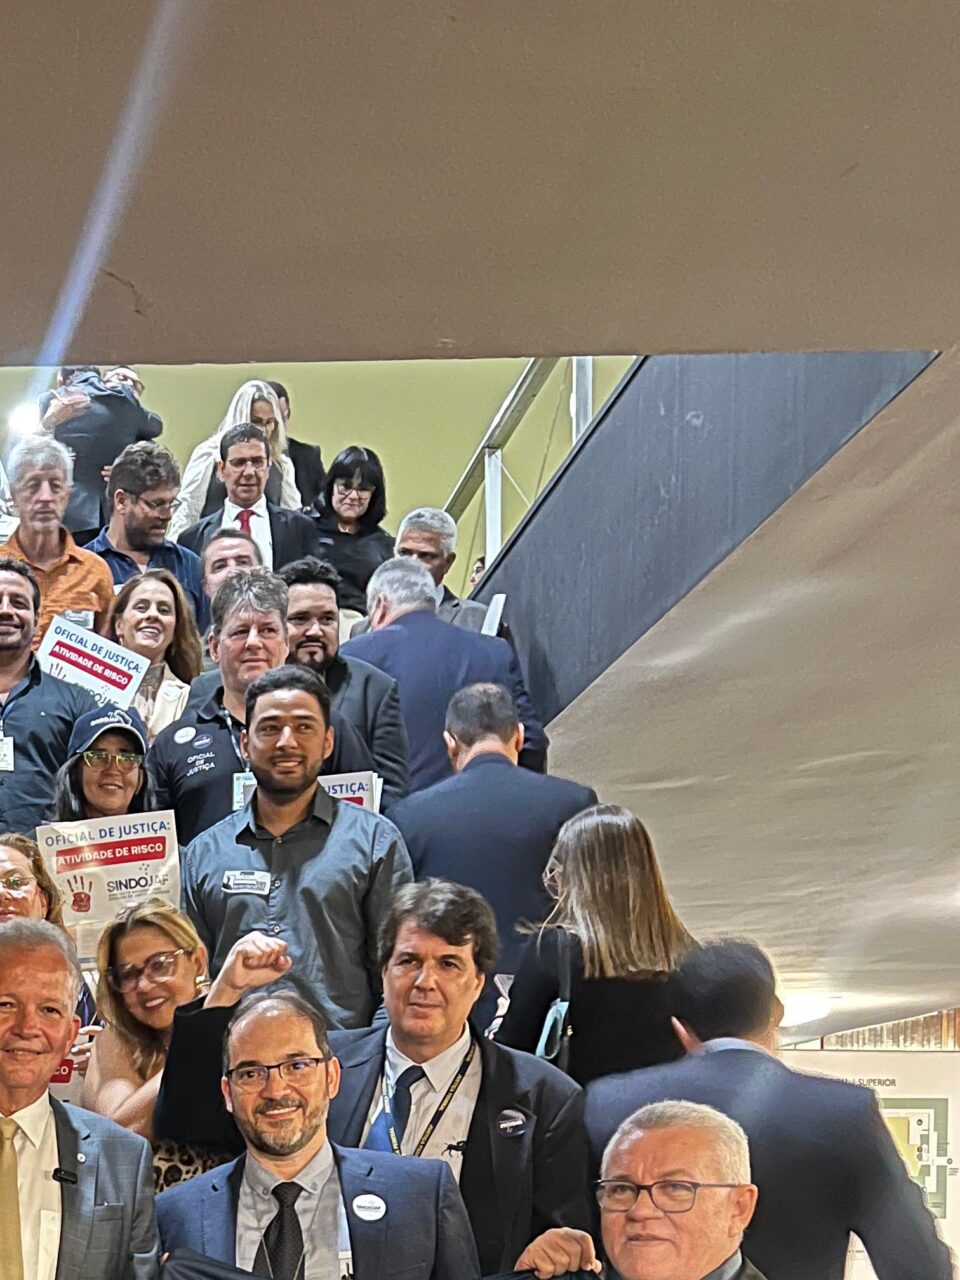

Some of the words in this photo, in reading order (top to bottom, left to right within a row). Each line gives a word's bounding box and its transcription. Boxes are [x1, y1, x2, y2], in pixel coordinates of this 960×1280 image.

[54, 625, 89, 648] OFICIAL
[91, 643, 105, 654] DE
[103, 649, 143, 674] JUSTIÇA:
[53, 645, 93, 668] ATIVIDADE
[93, 663, 104, 674] DE
[104, 668, 129, 684] RISCO
[187, 752, 215, 763] OFICIAL
[186, 762, 216, 776] JUSTIÇA
[327, 782, 368, 795] STIÇA:
[45, 831, 95, 847] OFICIAL
[99, 826, 115, 839] DE
[118, 820, 171, 839] JUSTIÇA:
[57, 848, 114, 865] ATIVIDADE
[115, 847, 129, 857] DE
[131, 842, 163, 855] RISCO
[858, 1078, 897, 1087] SUPERIOR
